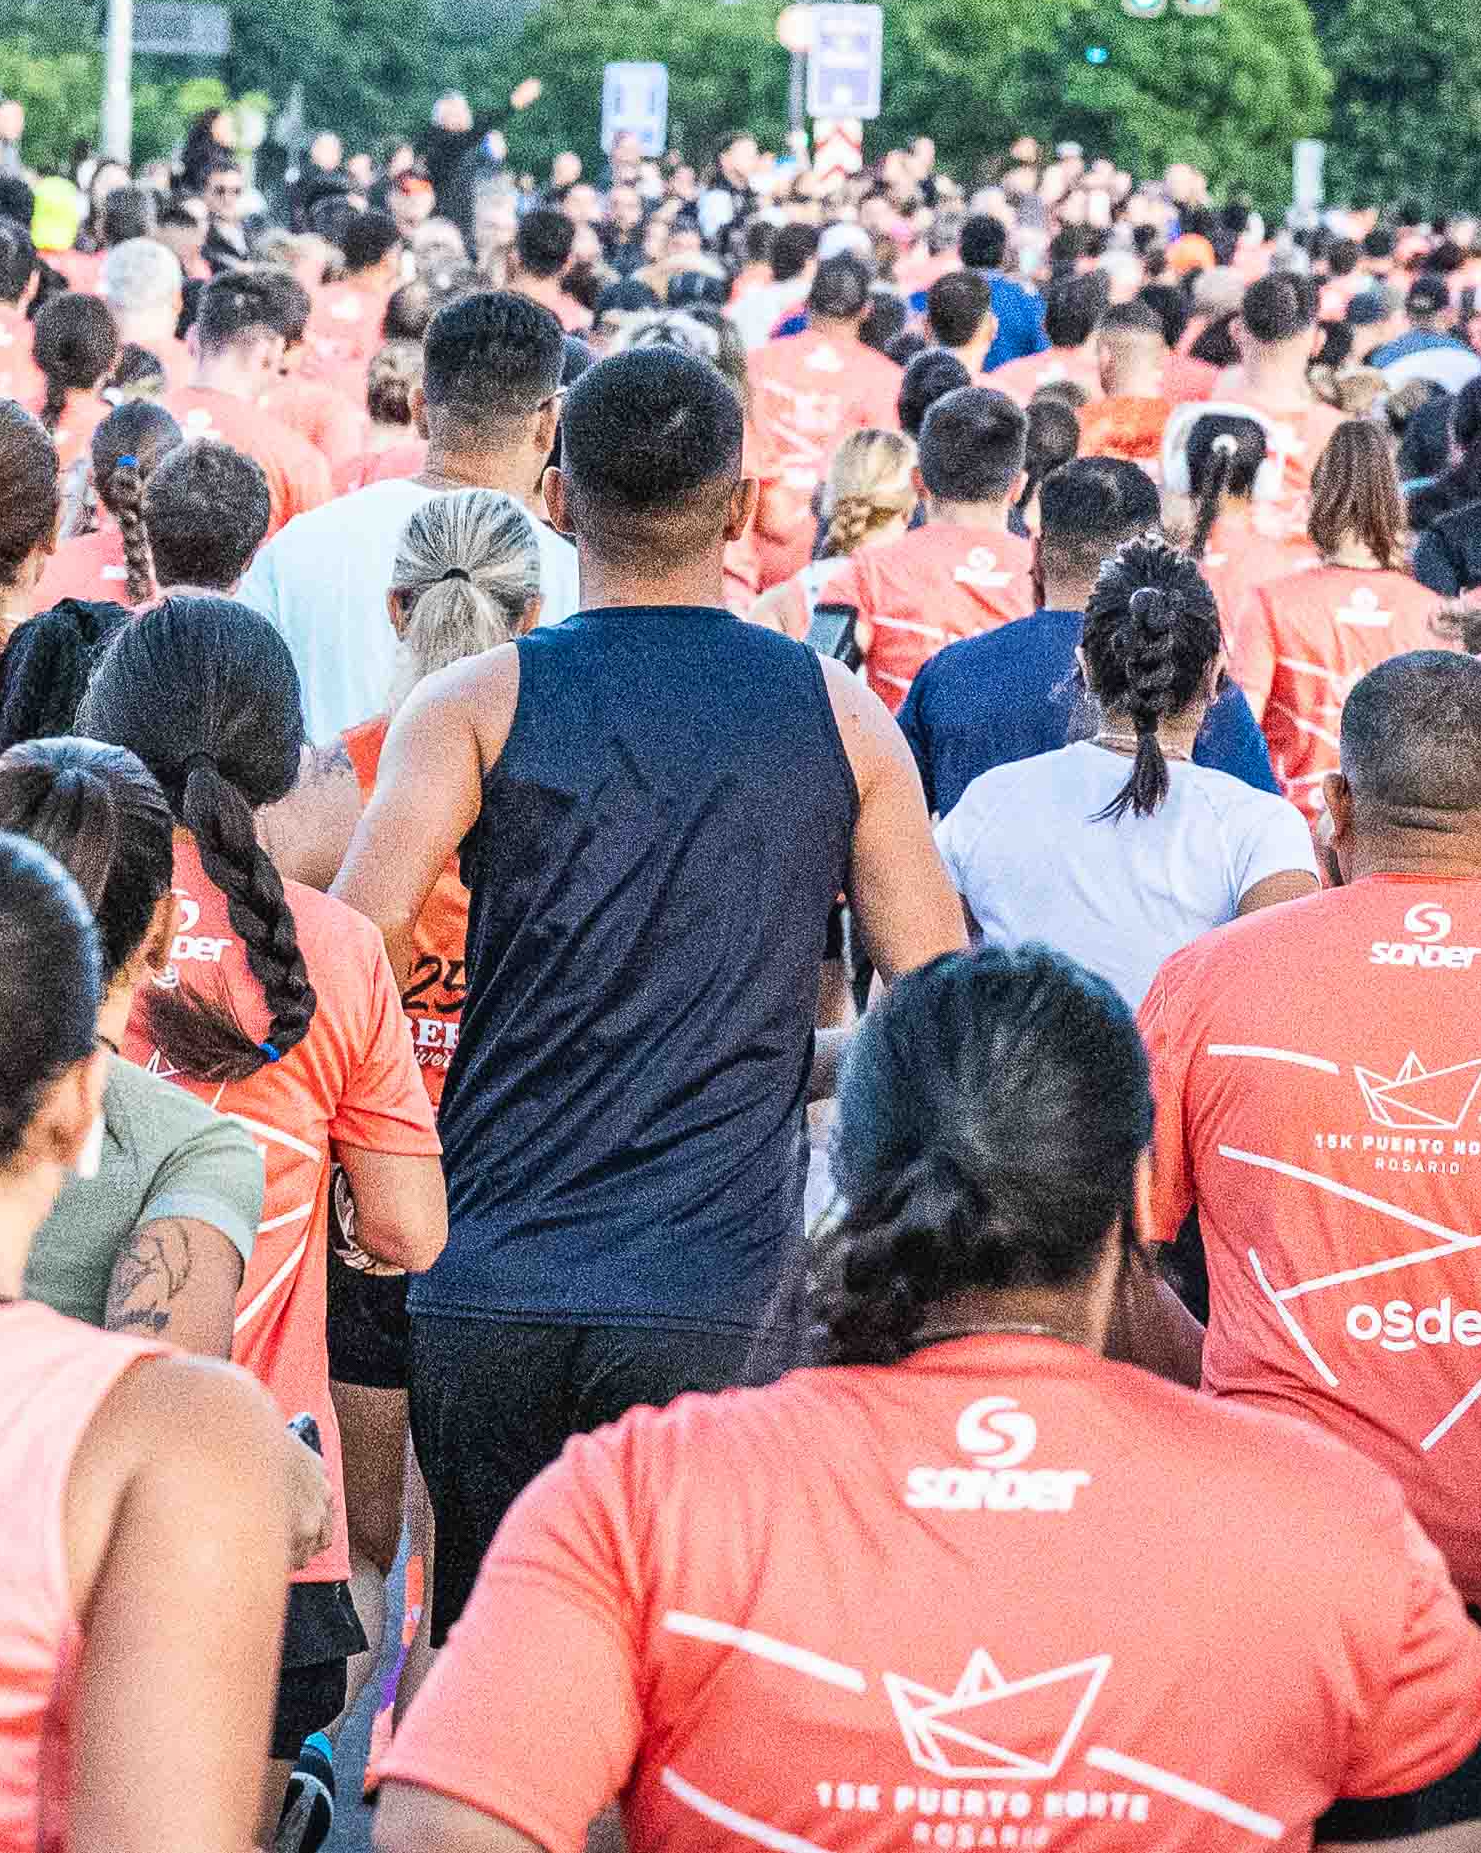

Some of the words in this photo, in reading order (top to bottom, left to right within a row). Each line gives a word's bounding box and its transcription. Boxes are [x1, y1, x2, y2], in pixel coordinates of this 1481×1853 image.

[1315, 1133, 1354, 1150] 15K
[1362, 1134, 1445, 1155] PUERTO
[1375, 1156, 1461, 1175] ROSARIO
[894, 1784, 1033, 1819] PUERTO
[1044, 1791, 1150, 1823] NORTE
